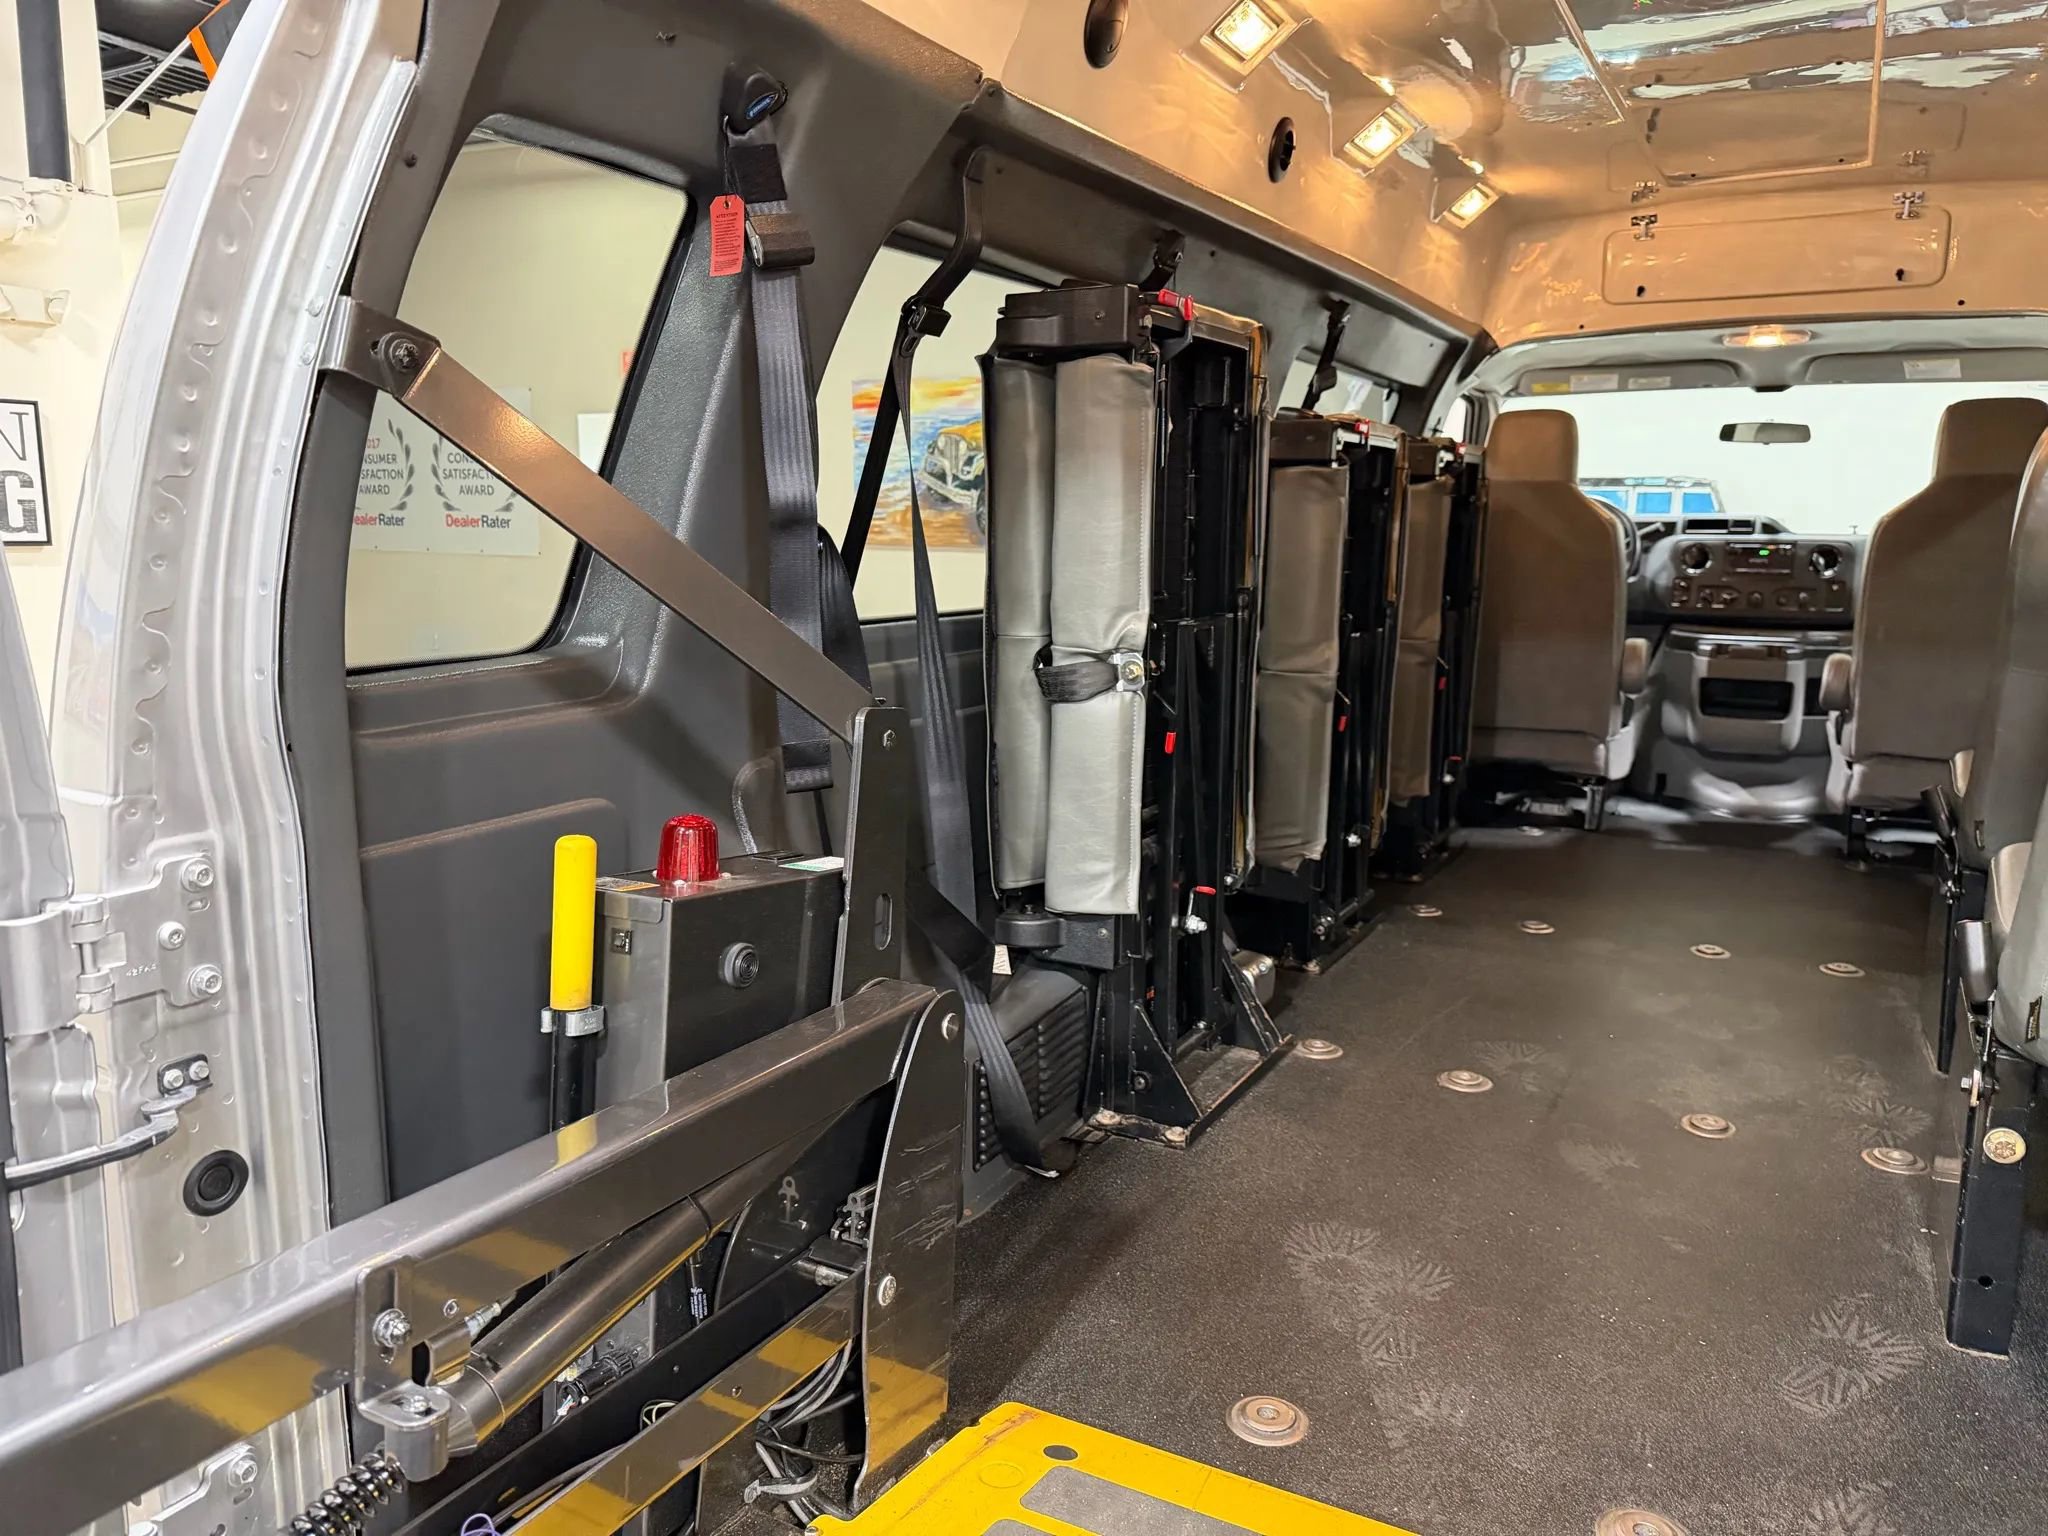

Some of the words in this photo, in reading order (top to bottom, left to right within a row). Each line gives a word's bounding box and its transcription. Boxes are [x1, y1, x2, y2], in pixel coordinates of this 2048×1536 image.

[367, 438, 381, 449] 017
[361, 468, 405, 480] SFACTION
[459, 484, 495, 496] AWARD
[354, 513, 405, 526] ealerRater
[445, 513, 512, 529] DealerRater
